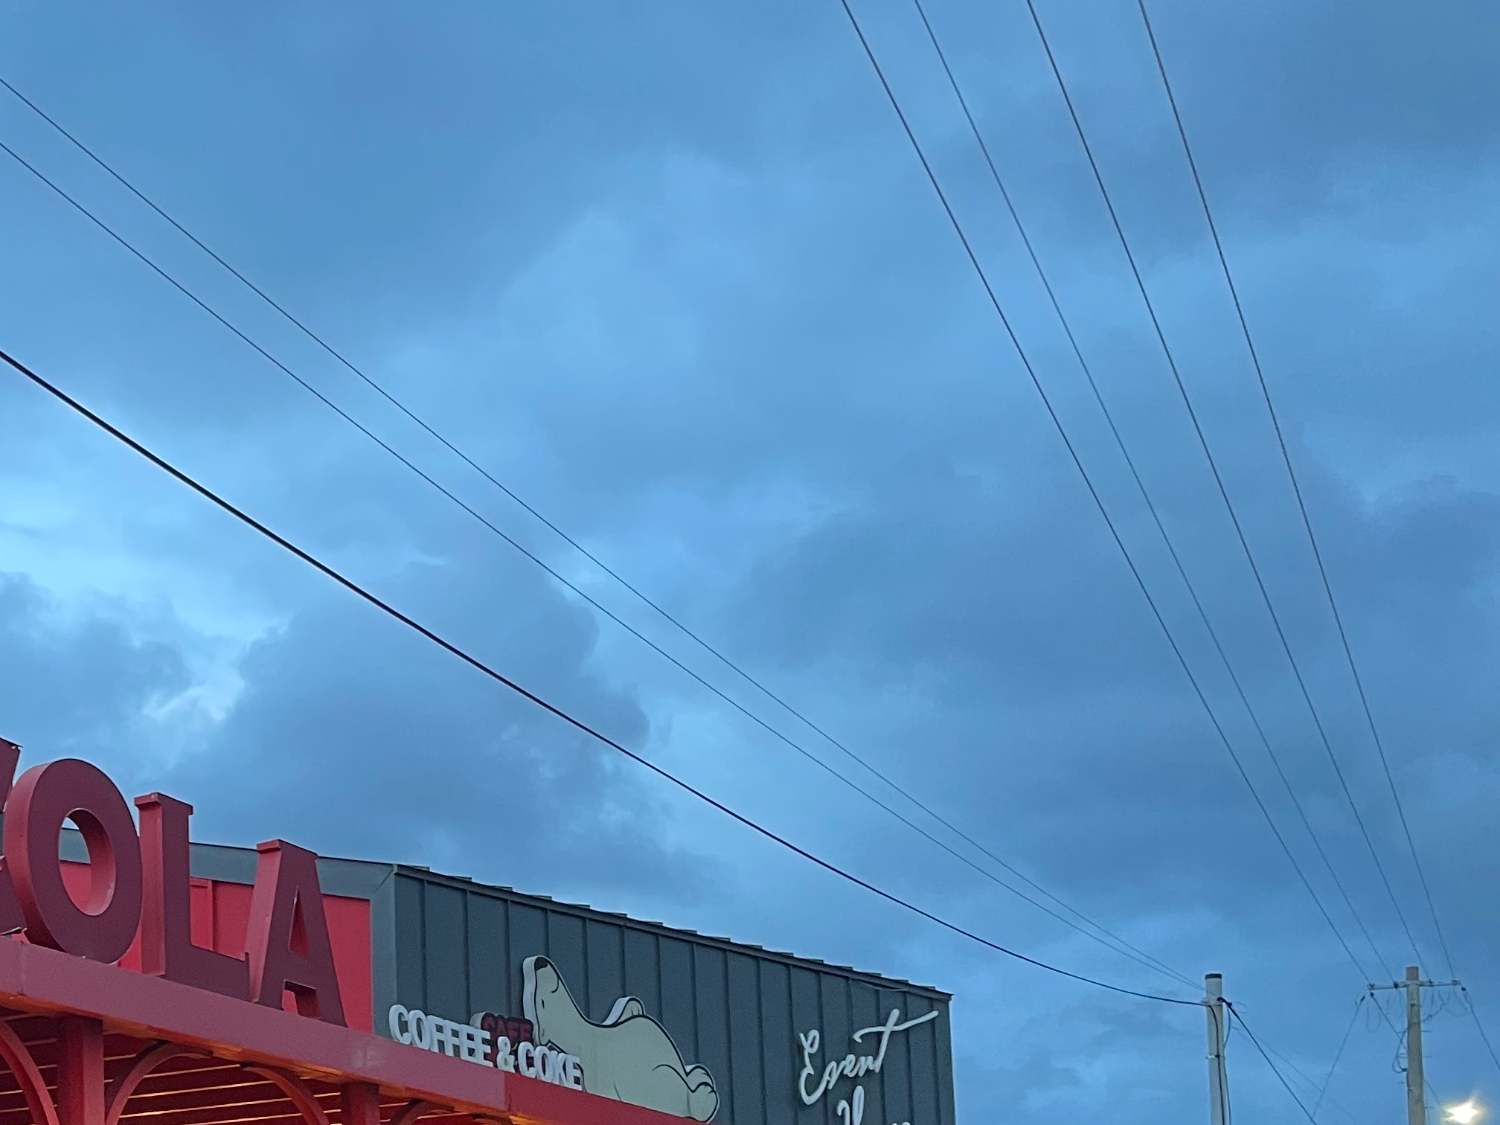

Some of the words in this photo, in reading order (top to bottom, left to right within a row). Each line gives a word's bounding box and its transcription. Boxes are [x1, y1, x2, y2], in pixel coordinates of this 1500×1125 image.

[388, 1004, 494, 1068] COFFEE
[496, 1036, 516, 1073] &
[518, 1041, 583, 1092] COKE
[799, 1008, 939, 1106] Event
